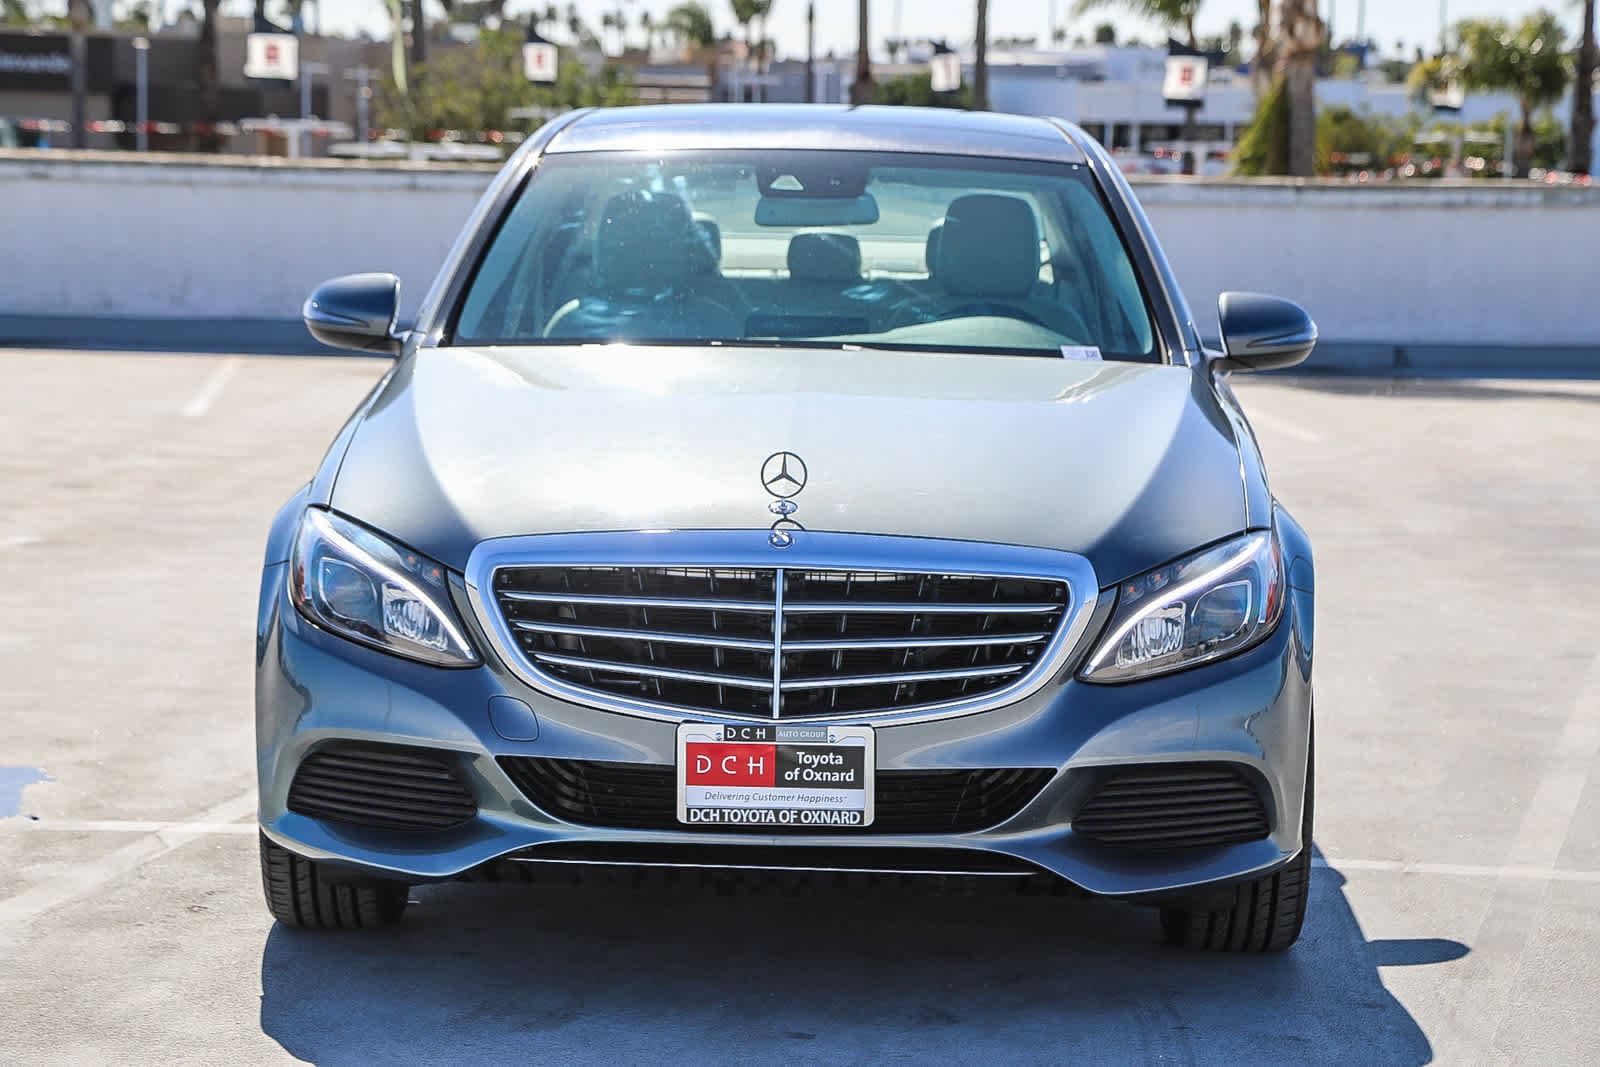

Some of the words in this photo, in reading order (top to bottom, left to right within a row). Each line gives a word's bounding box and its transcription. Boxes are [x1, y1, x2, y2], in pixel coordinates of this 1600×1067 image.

[726, 727, 766, 739] DCH
[778, 730, 798, 738] AUTO
[800, 730, 825, 738] GROUP
[696, 755, 764, 775] DCH
[796, 751, 843, 768] Toyota
[784, 768, 800, 781] of
[802, 769, 854, 782] Oxnard
[704, 791, 750, 802] Delivering
[752, 792, 795, 801] Customer
[690, 808, 720, 822] DCH
[723, 809, 776, 823] TOYOTA
[778, 810, 799, 823] OF
[801, 810, 861, 824] OXNARD
